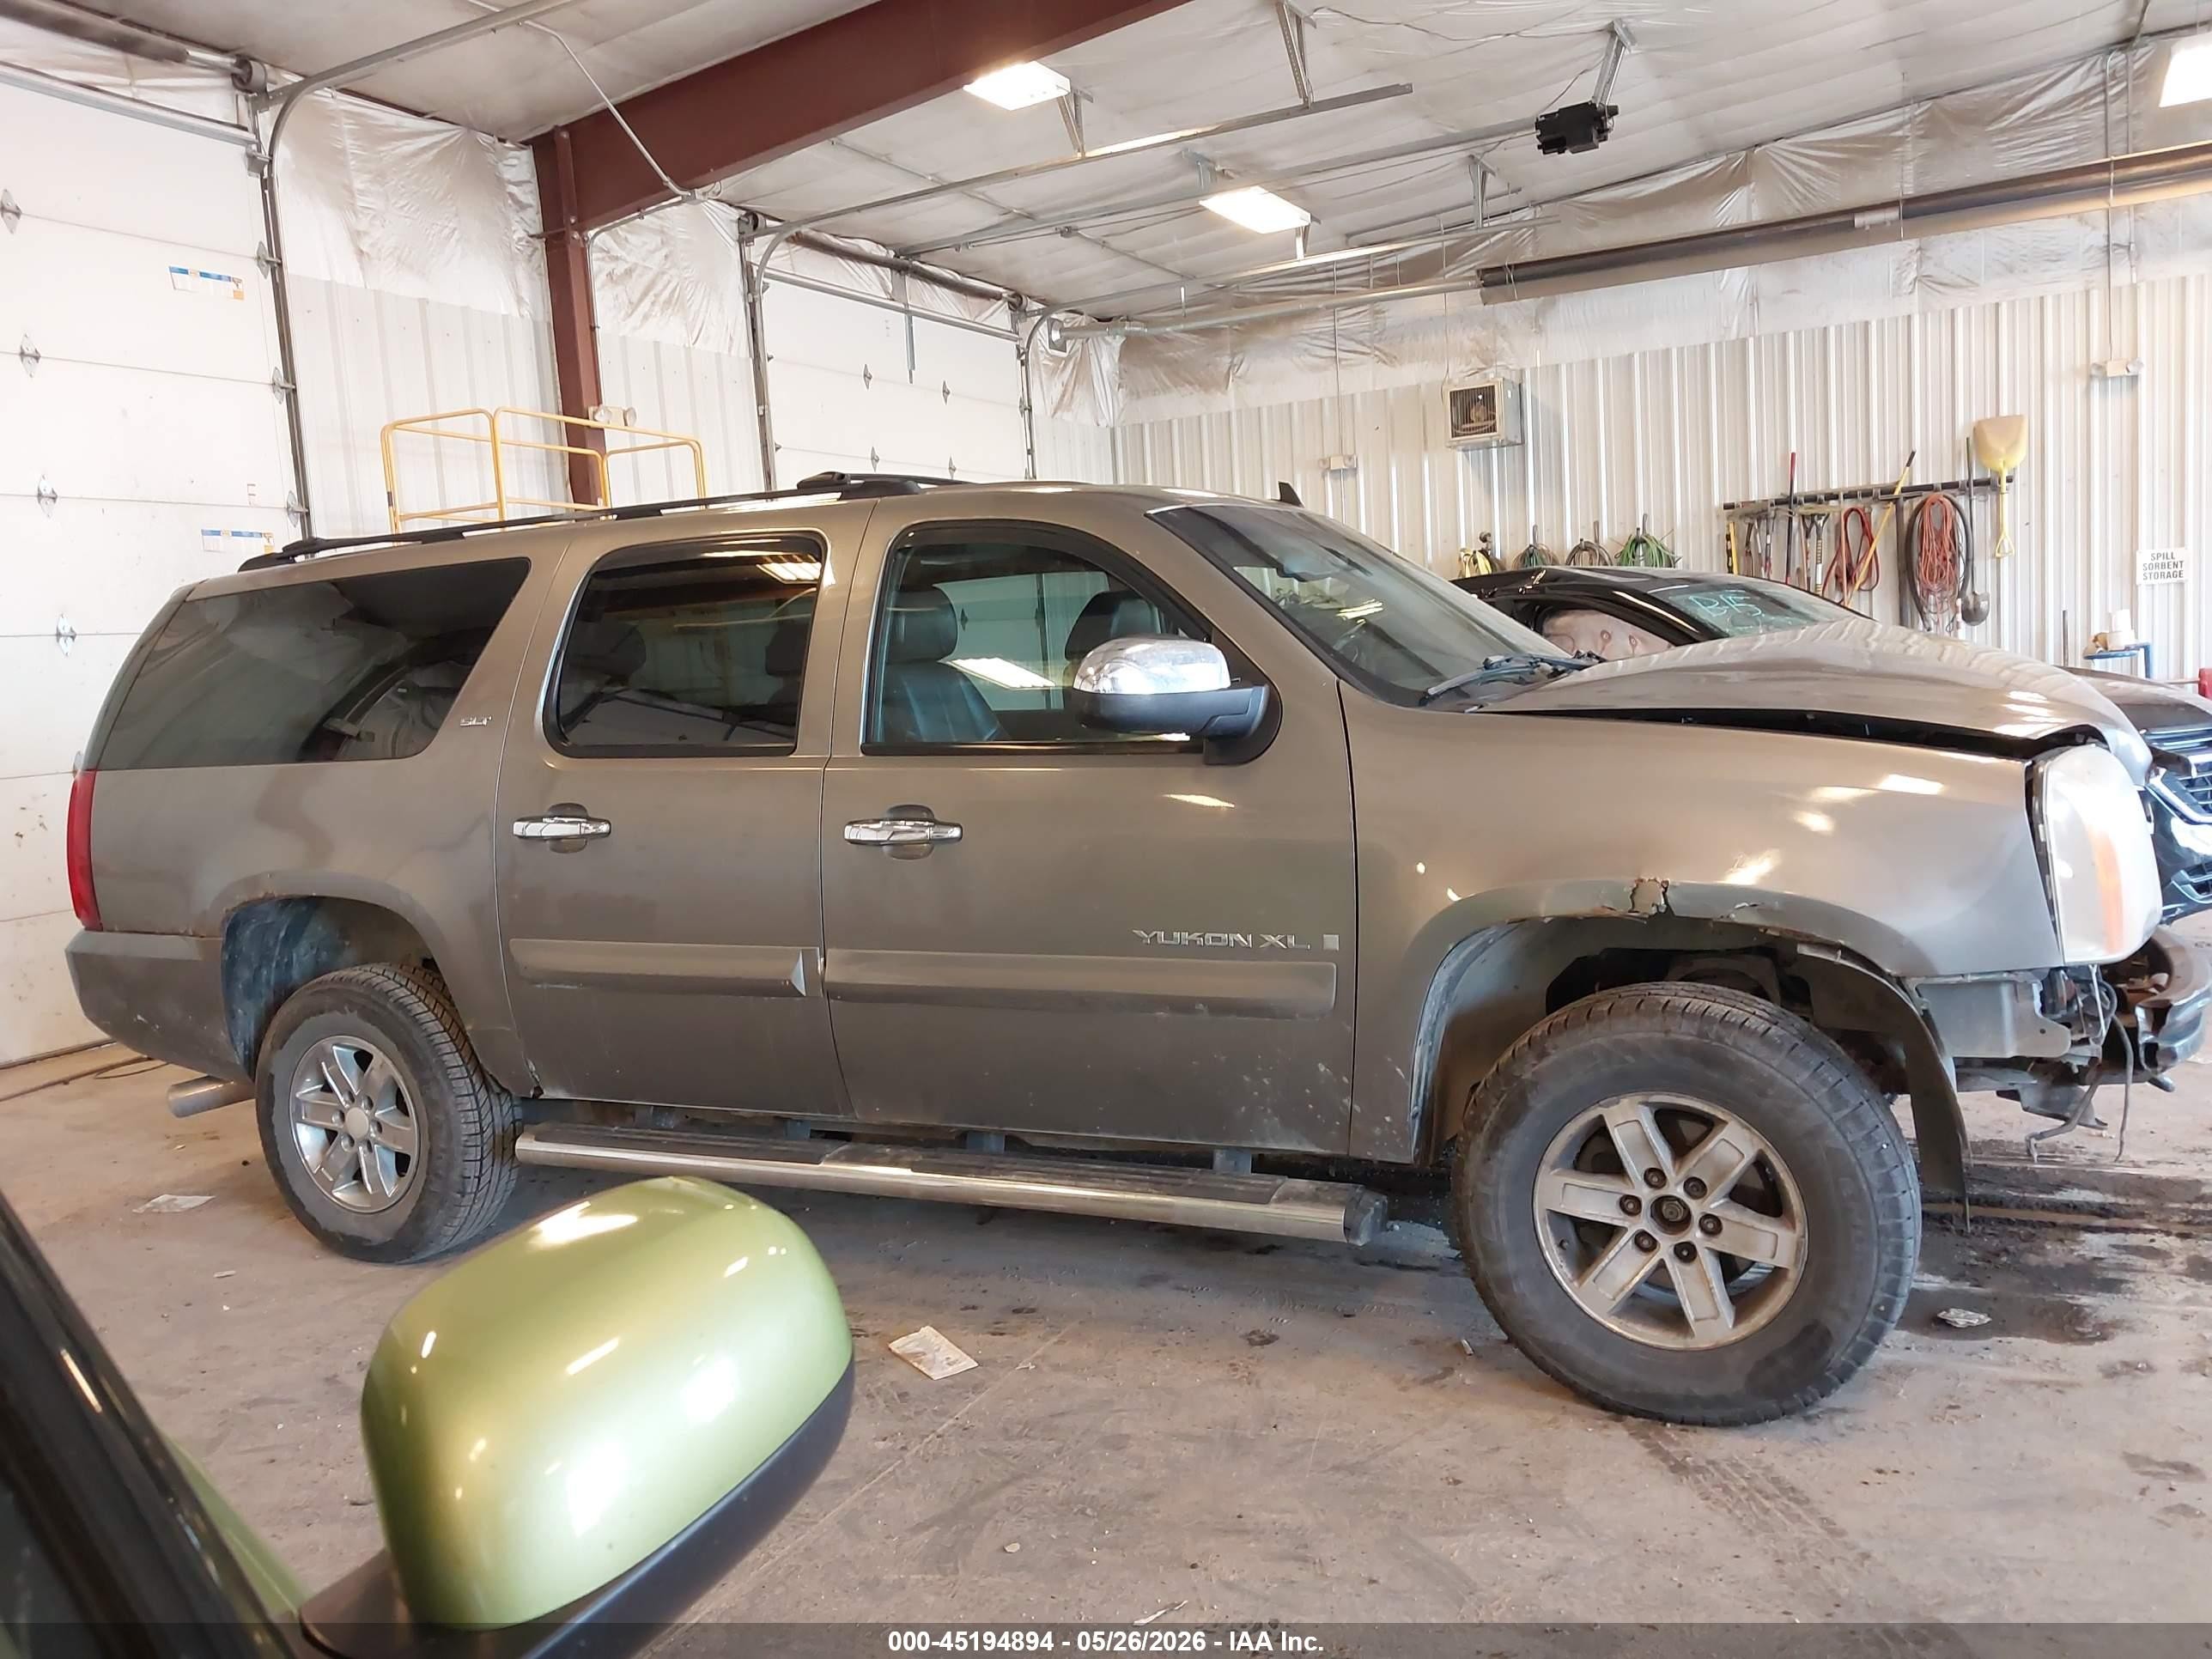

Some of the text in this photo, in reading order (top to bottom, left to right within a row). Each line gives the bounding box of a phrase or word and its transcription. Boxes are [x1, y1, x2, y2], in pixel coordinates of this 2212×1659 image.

[2151, 552, 2175, 561] SPILL
[2143, 561, 2184, 571] SORBENT
[2143, 570, 2184, 580] STORAGE
[1132, 929, 1310, 950] YUKON XL
